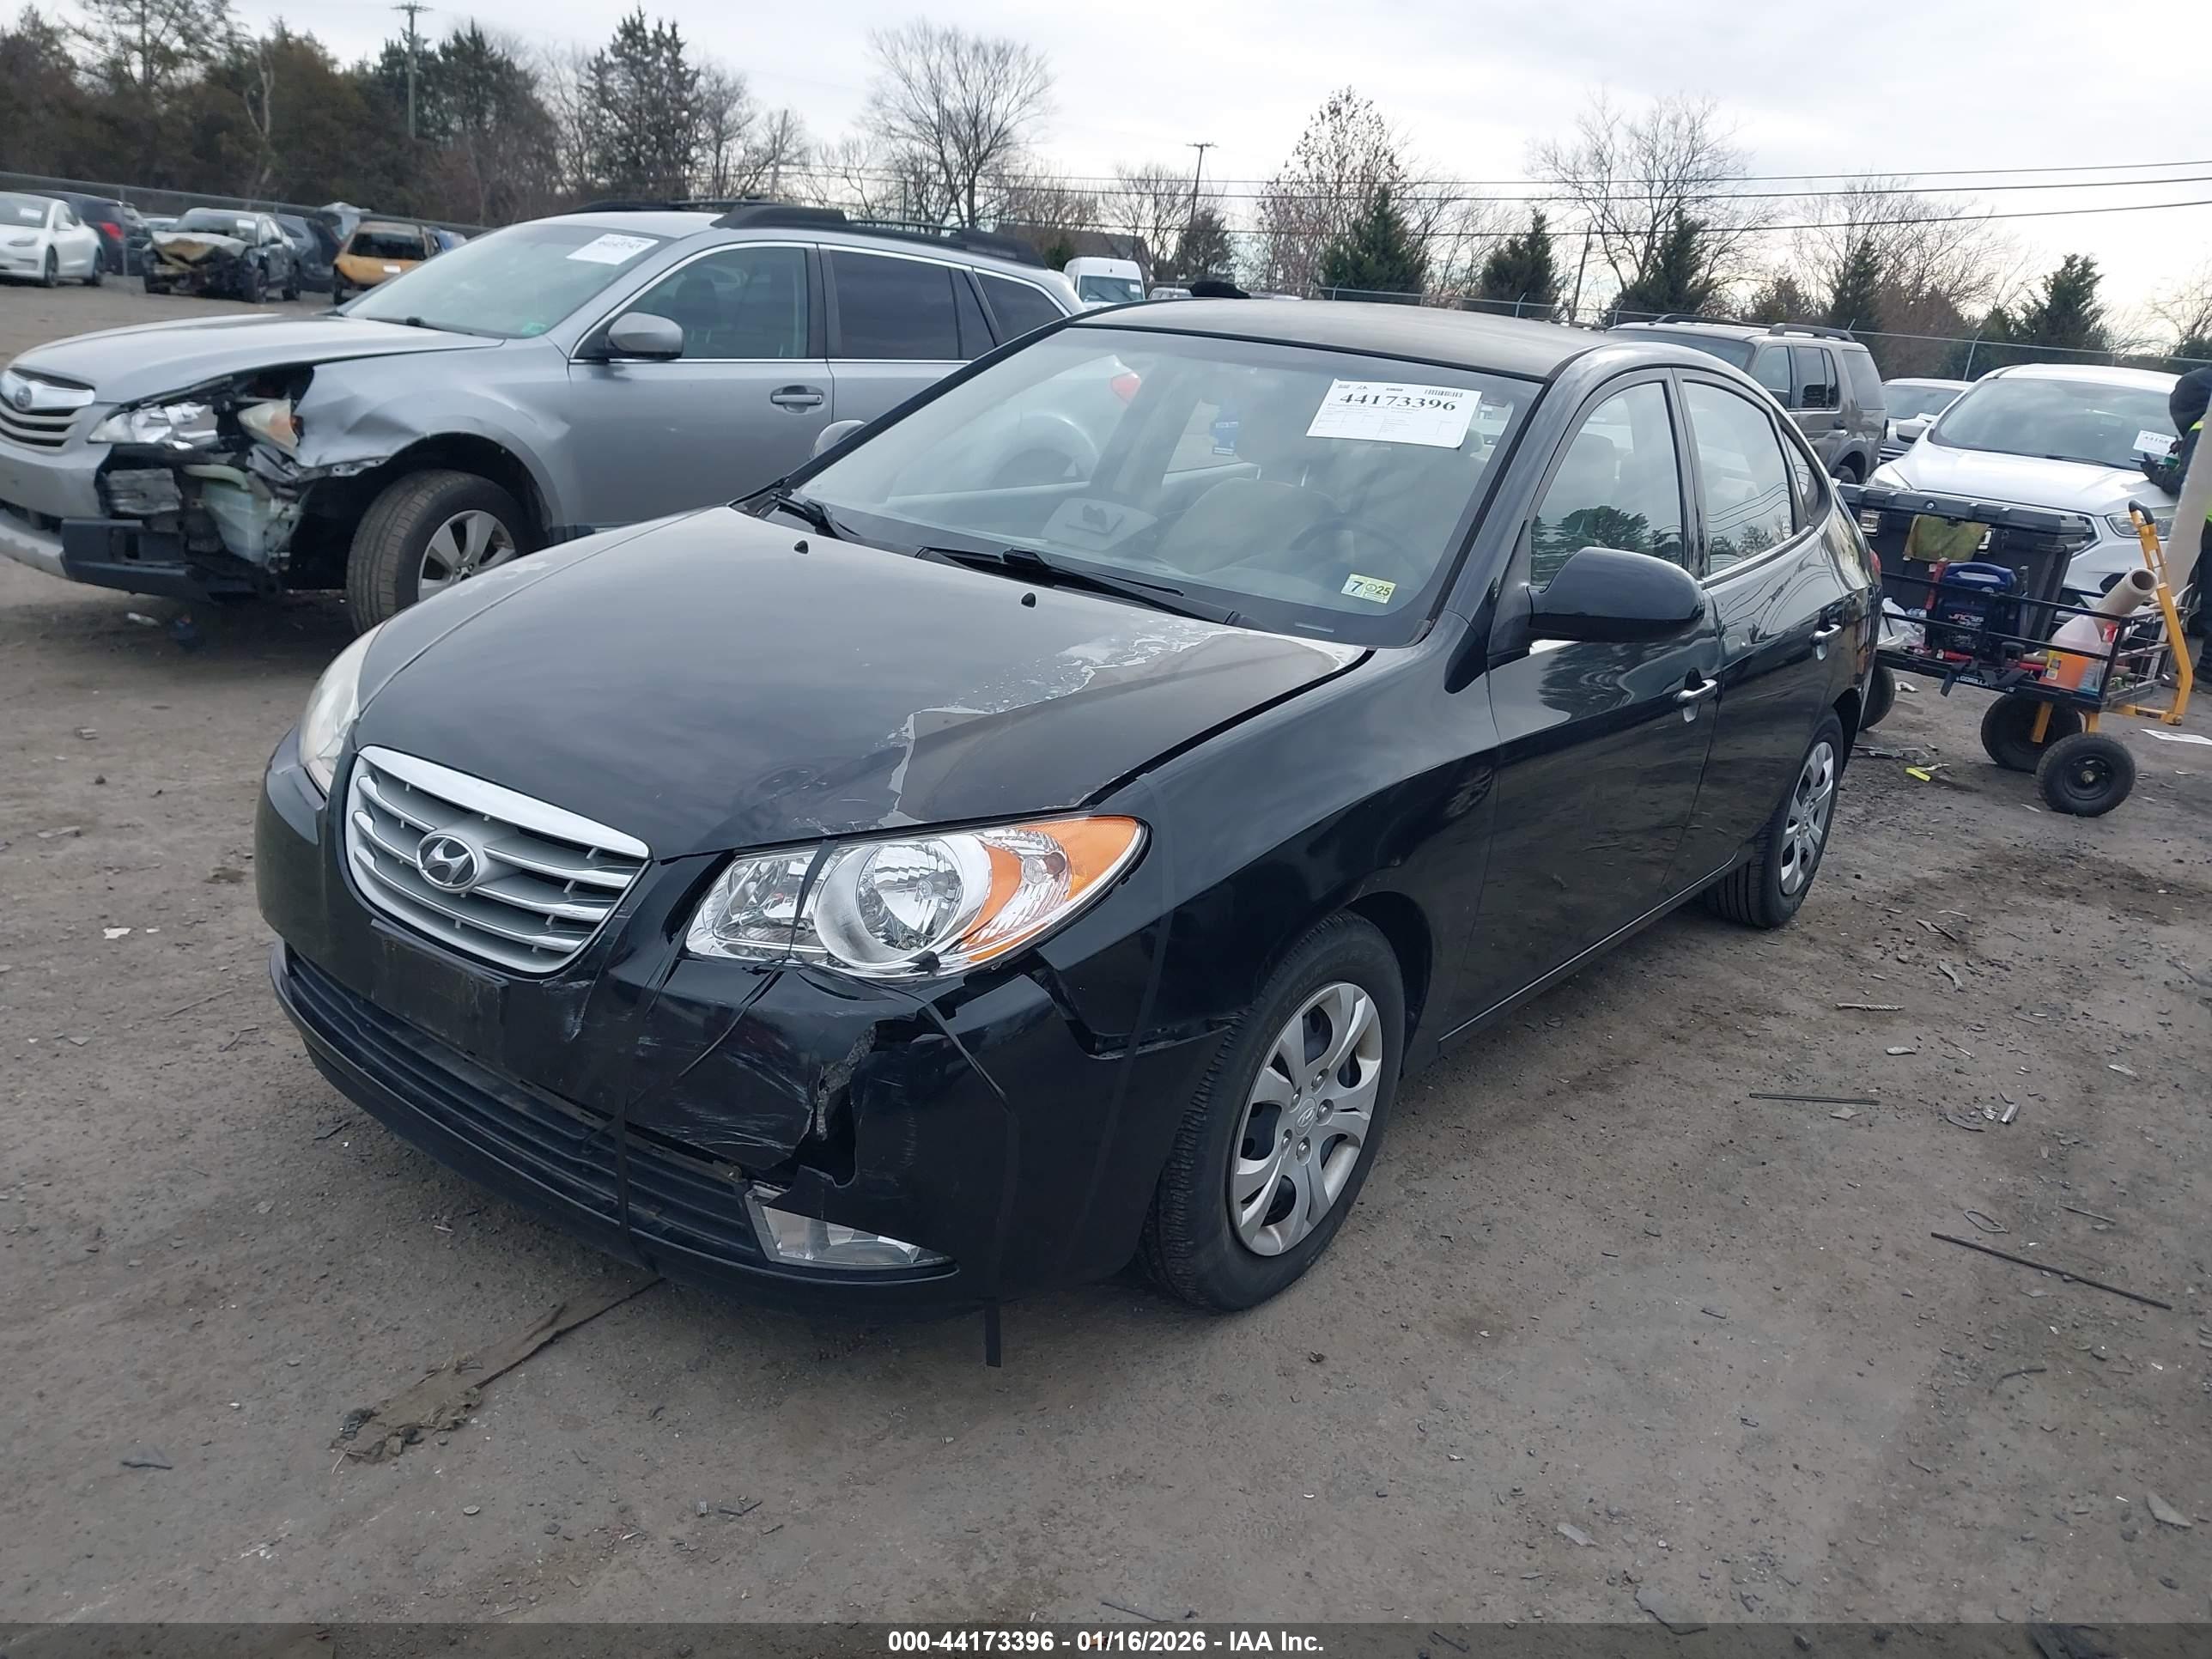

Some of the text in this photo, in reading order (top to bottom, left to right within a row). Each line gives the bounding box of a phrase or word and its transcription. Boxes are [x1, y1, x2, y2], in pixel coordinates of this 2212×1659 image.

[1340, 393, 1457, 411] 44173396
[1352, 580, 1391, 596] 7 25
